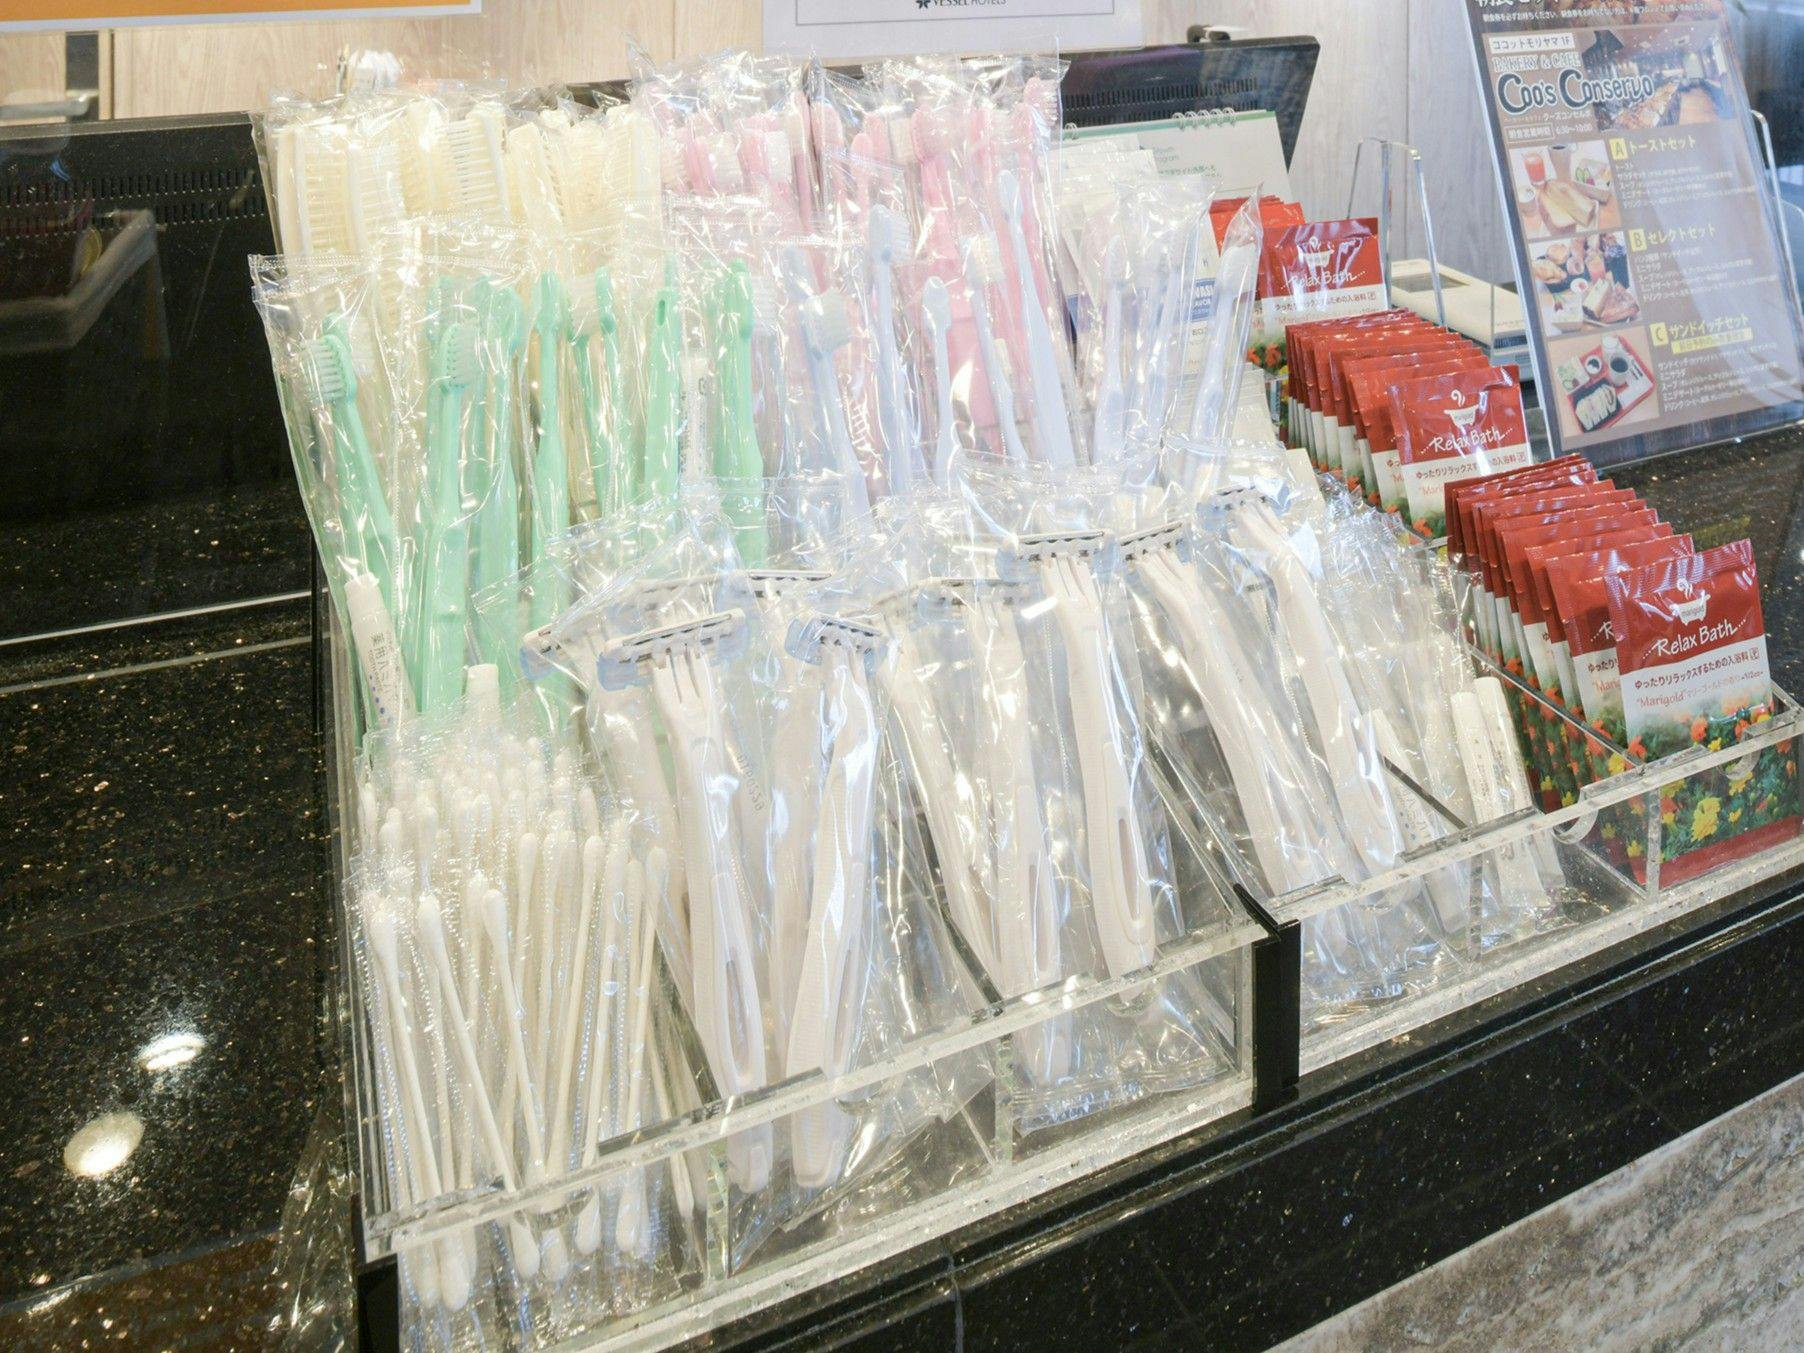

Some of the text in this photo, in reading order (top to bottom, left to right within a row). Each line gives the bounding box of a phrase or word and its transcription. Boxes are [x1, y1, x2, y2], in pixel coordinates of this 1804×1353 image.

[1498, 69, 1654, 114] Coo's Conservo
[1628, 135, 1696, 153] トーストセット
[1648, 224, 1716, 244] セレクトセット
[1669, 313, 1749, 337] サンドイッチセット
[1429, 427, 1504, 452] Relax Bath
[1650, 620, 1738, 657] Relax Bath
